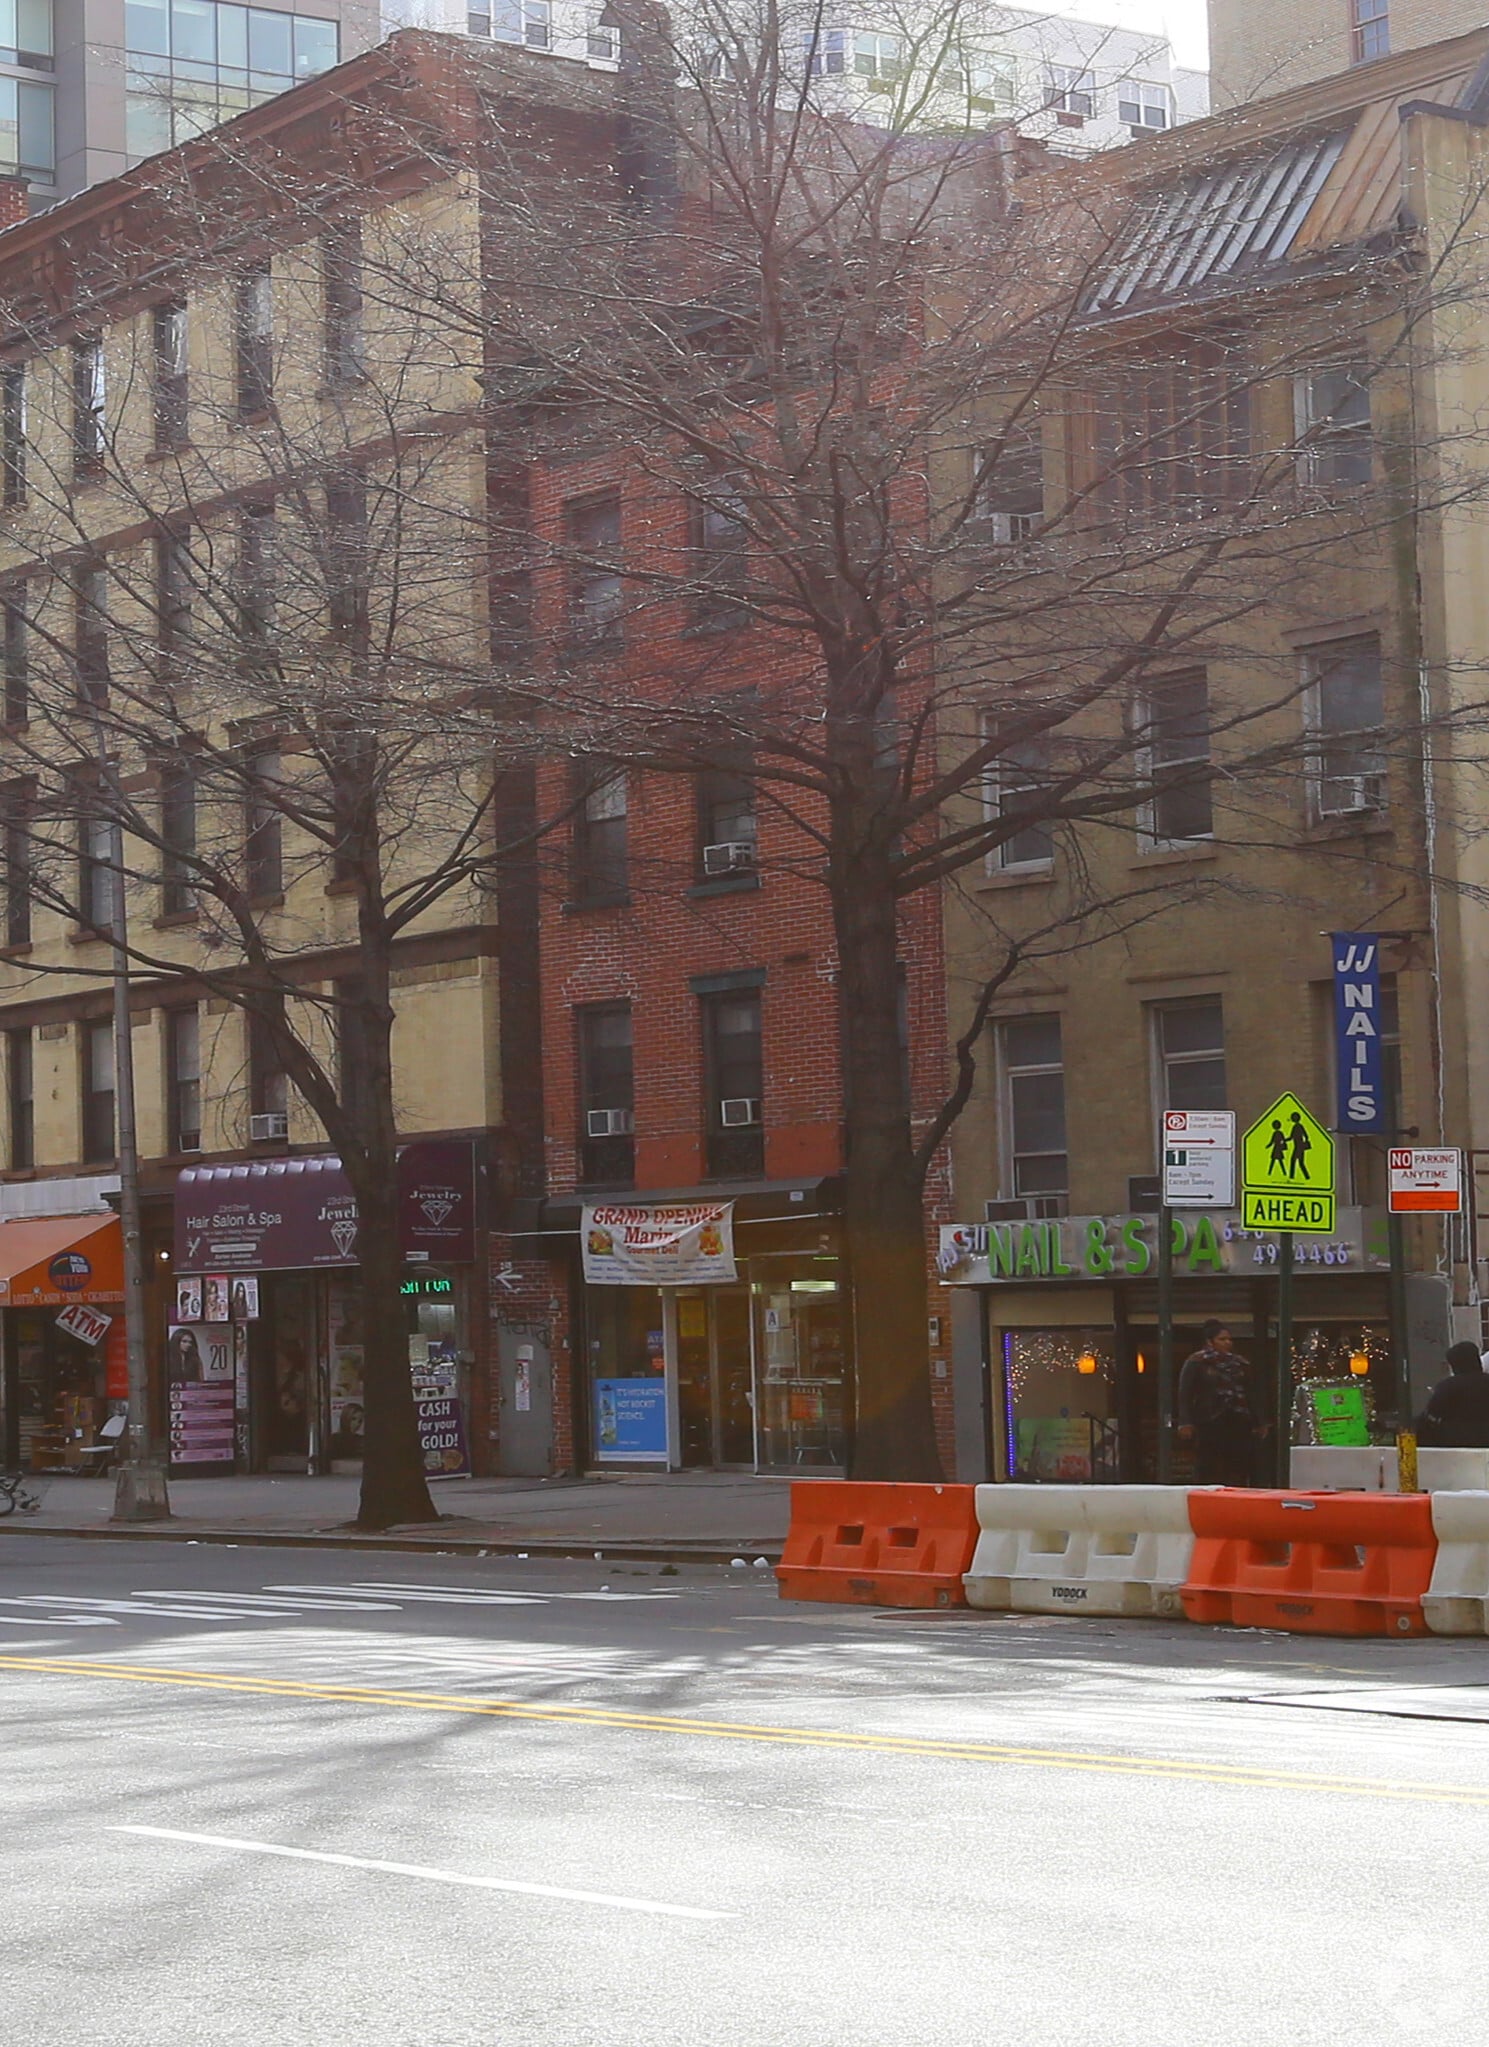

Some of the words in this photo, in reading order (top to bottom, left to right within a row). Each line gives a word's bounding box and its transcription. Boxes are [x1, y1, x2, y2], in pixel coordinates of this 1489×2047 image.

[1337, 945, 1375, 972] JJ
[1345, 984, 1377, 1121] NAILS
[1172, 1150, 1179, 1165] 1
[1392, 1153, 1411, 1167] NO
[1415, 1154, 1455, 1163] PARKING
[1402, 1170, 1449, 1178] ANYTIME
[409, 1190, 461, 1202] Jewelry
[186, 1216, 209, 1229] Hair
[212, 1214, 244, 1228] Salon
[247, 1213, 256, 1225] &
[259, 1211, 282, 1228] Spa
[592, 1207, 648, 1225] GRAND
[1254, 1199, 1323, 1223] AHEAD
[988, 1222, 1072, 1277] NAIL
[1085, 1219, 1115, 1275] &
[1253, 1242, 1349, 1265] 494466
[60, 1306, 107, 1340] ATM
[768, 1311, 777, 1326] A
[210, 1345, 227, 1370] 20
[419, 1401, 451, 1417] CASH
[418, 1420, 432, 1431] for
[434, 1420, 457, 1432] your
[421, 1434, 459, 1450] GOLD!
